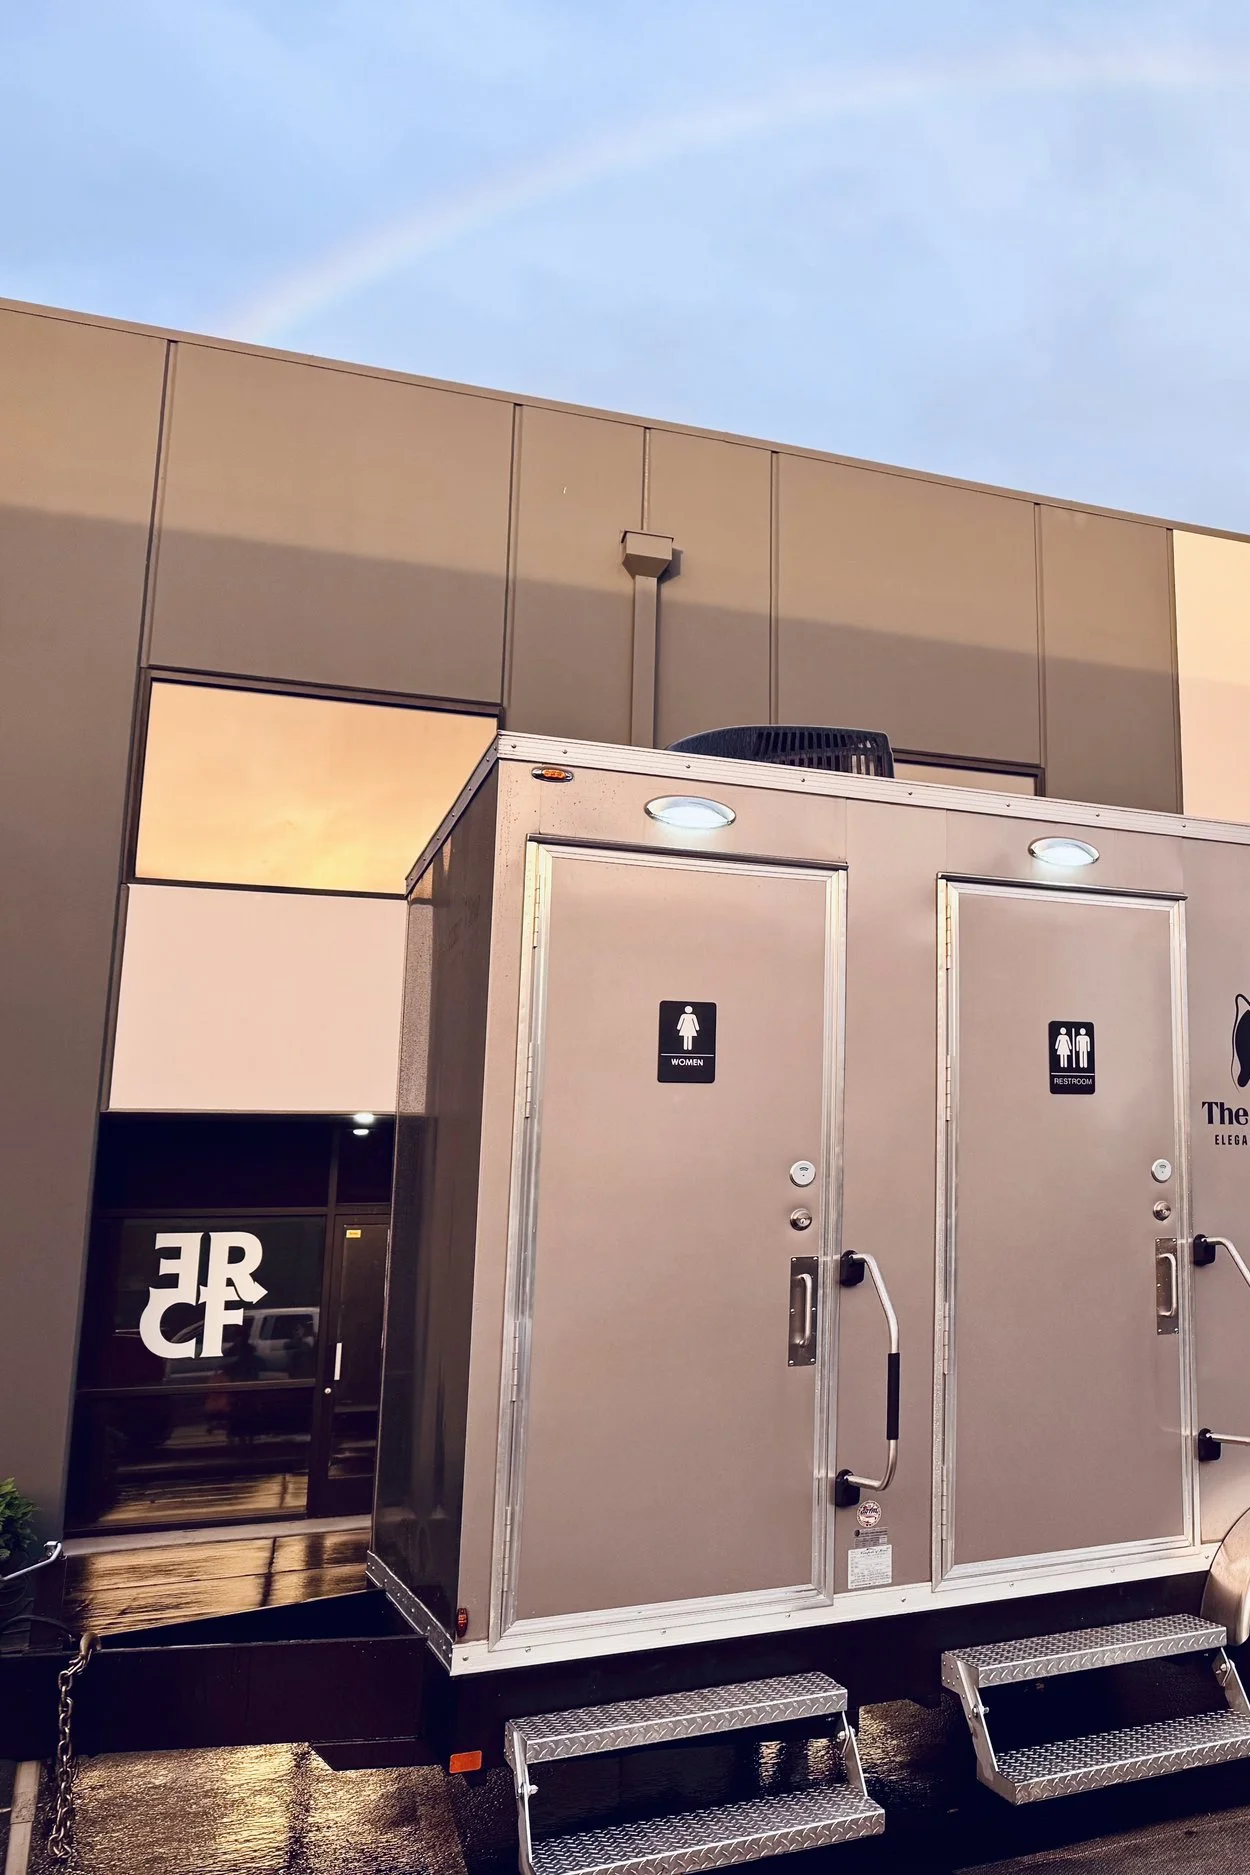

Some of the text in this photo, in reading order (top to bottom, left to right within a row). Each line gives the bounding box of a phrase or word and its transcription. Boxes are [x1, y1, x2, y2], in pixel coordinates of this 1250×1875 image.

[671, 1058, 704, 1066] WOMEN
[1053, 1077, 1093, 1085] RESTROOM
[1201, 1101, 1249, 1126] The
